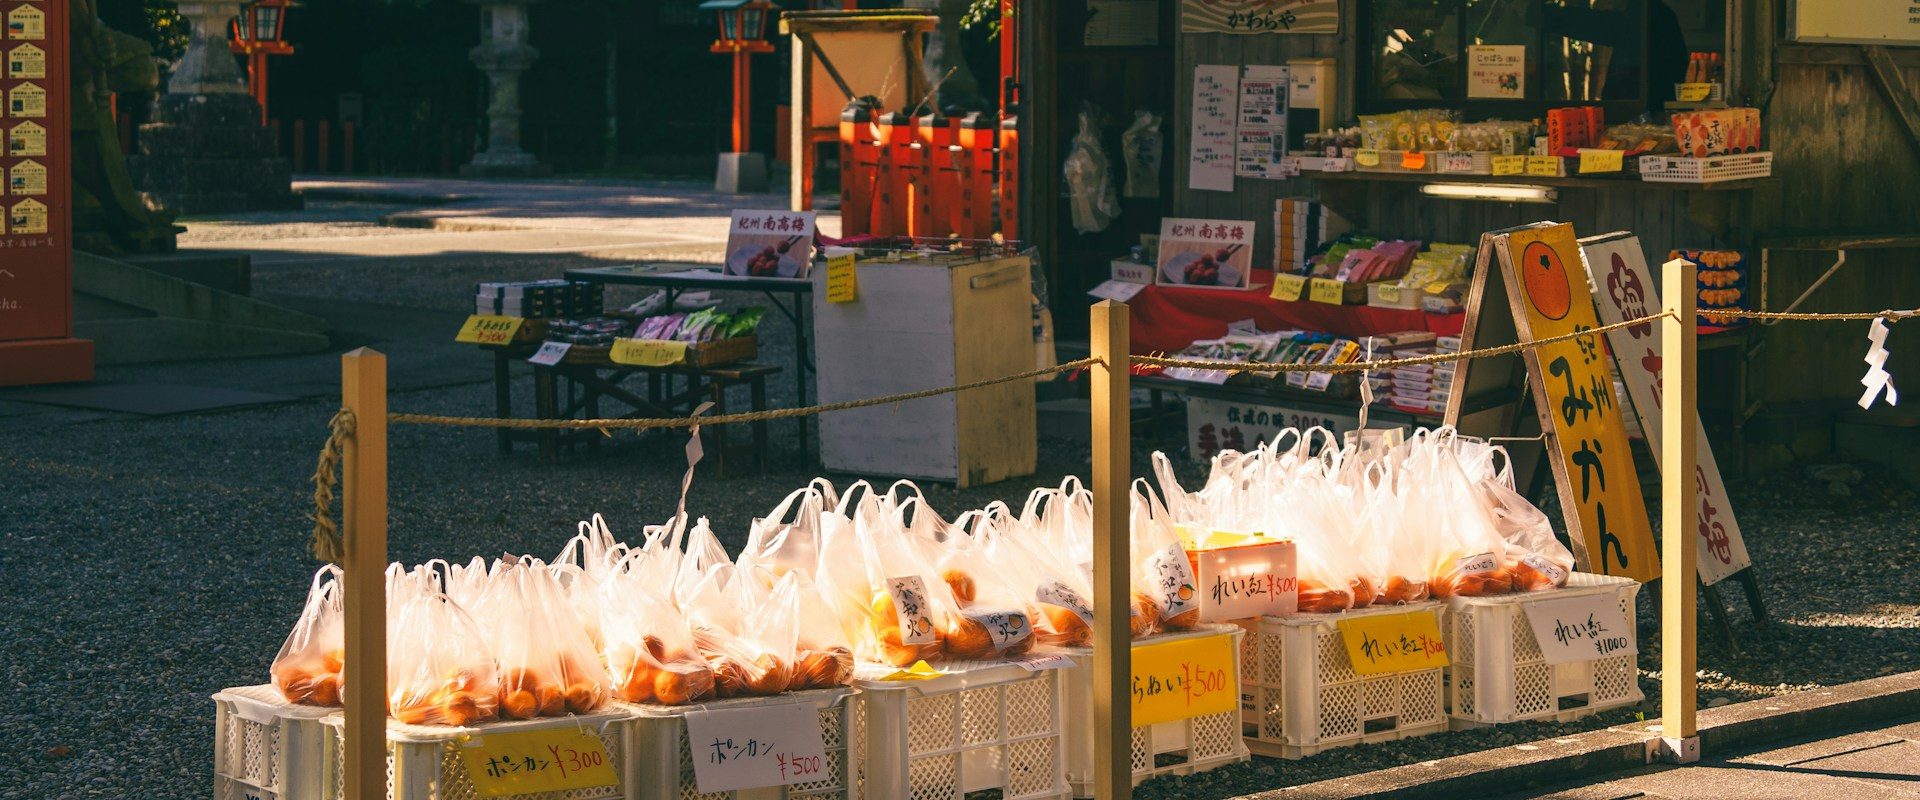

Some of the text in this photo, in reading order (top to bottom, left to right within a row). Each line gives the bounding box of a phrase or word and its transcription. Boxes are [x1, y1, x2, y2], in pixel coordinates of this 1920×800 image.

[1227, 10, 1297, 31] かわらや
[738, 215, 805, 232] 紀州 南高梅
[1171, 223, 1245, 240] 紀州 南高梅
[1574, 323, 1612, 418] 紀州
[1549, 356, 1629, 576] みかん
[1211, 572, 1298, 606] れい紅 ¥500
[895, 581, 922, 638] 不知火
[1553, 613, 1608, 647] れい紅
[1595, 636, 1629, 656] ¥1000
[1361, 631, 1446, 664] れい紅 ¥500
[1181, 661, 1226, 706] ¥500
[486, 744, 603, 779] ポンカン ¥300
[710, 737, 775, 765] ポンカン
[776, 752, 821, 781] ¥500
